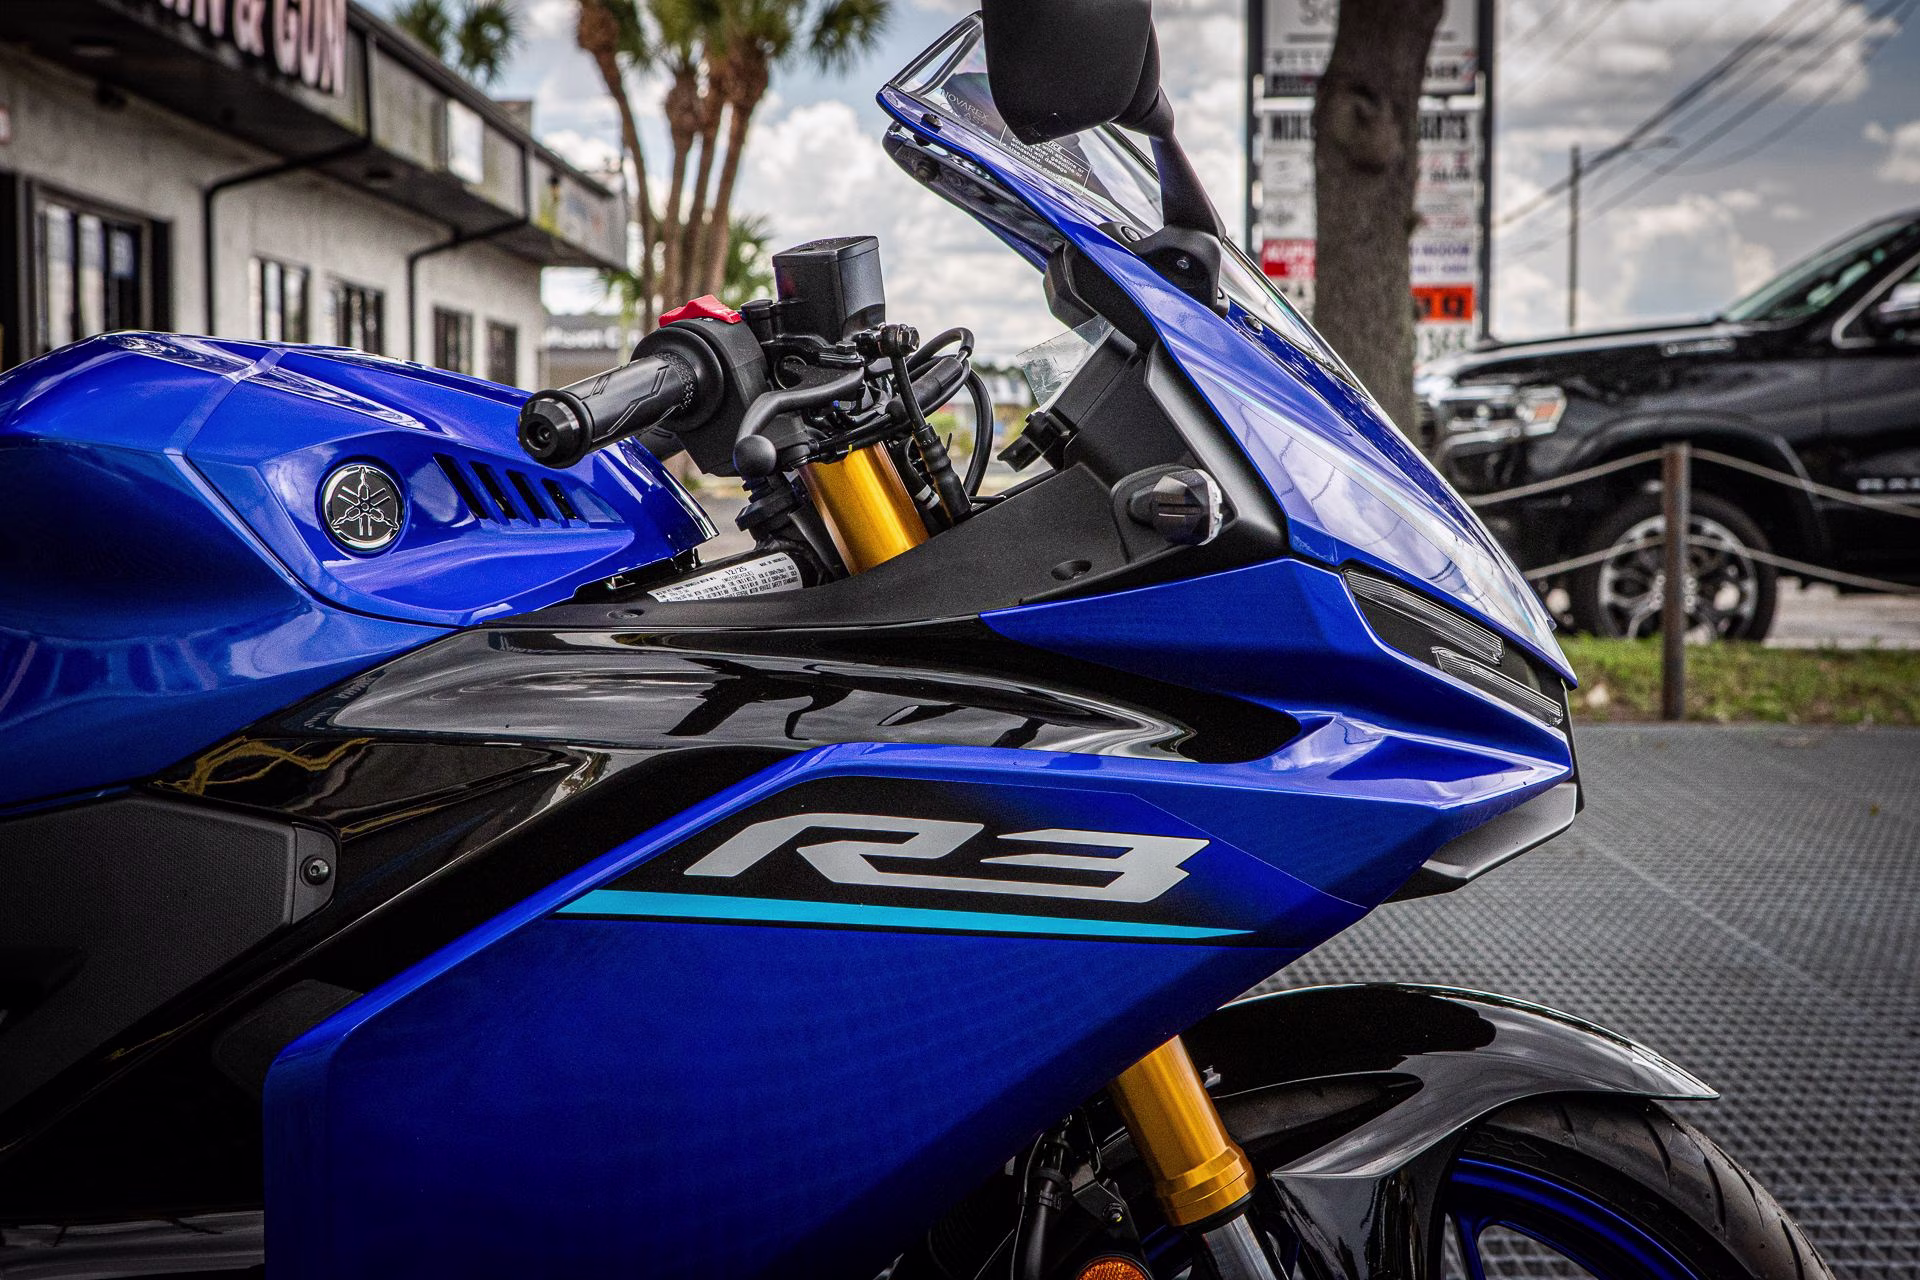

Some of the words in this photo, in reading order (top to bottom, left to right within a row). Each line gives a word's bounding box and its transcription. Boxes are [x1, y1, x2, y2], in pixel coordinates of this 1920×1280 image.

[273, 0, 346, 95] GUN
[939, 88, 989, 121] NOVAREX
[684, 813, 1209, 902] R3
